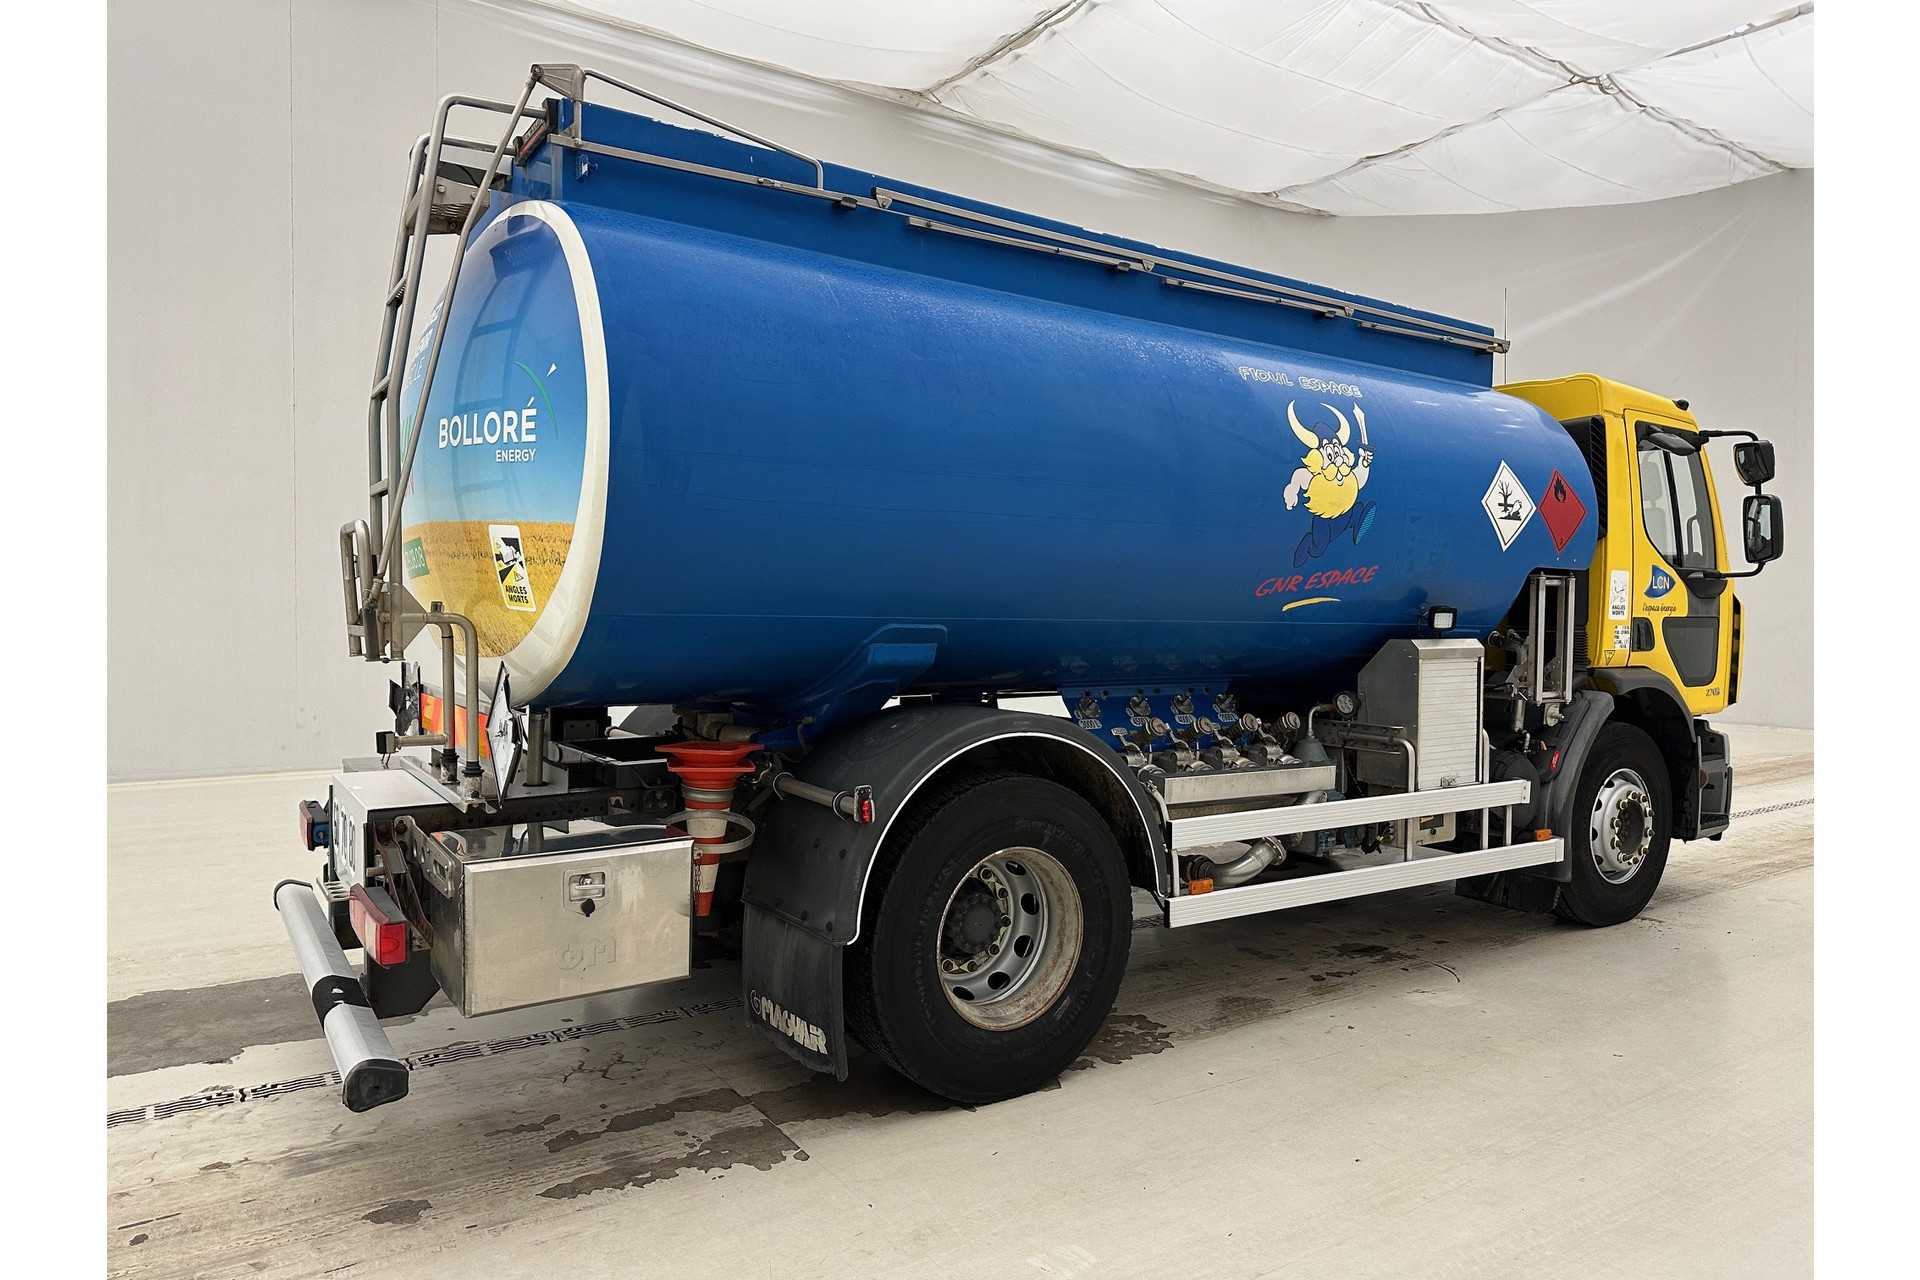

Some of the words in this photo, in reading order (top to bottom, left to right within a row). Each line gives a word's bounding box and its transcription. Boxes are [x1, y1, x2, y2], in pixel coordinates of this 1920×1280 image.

[1238, 366, 1294, 387] FIOUL
[1298, 376, 1363, 397] ESPACE
[438, 396, 537, 449] BOLLORÉ
[495, 448, 537, 462] ENERGY
[1255, 574, 1304, 597] GNR
[1304, 565, 1379, 589] ESPACE
[1652, 575, 1670, 590] LCN
[505, 584, 528, 595] ANGLES
[507, 594, 529, 604] MORTS
